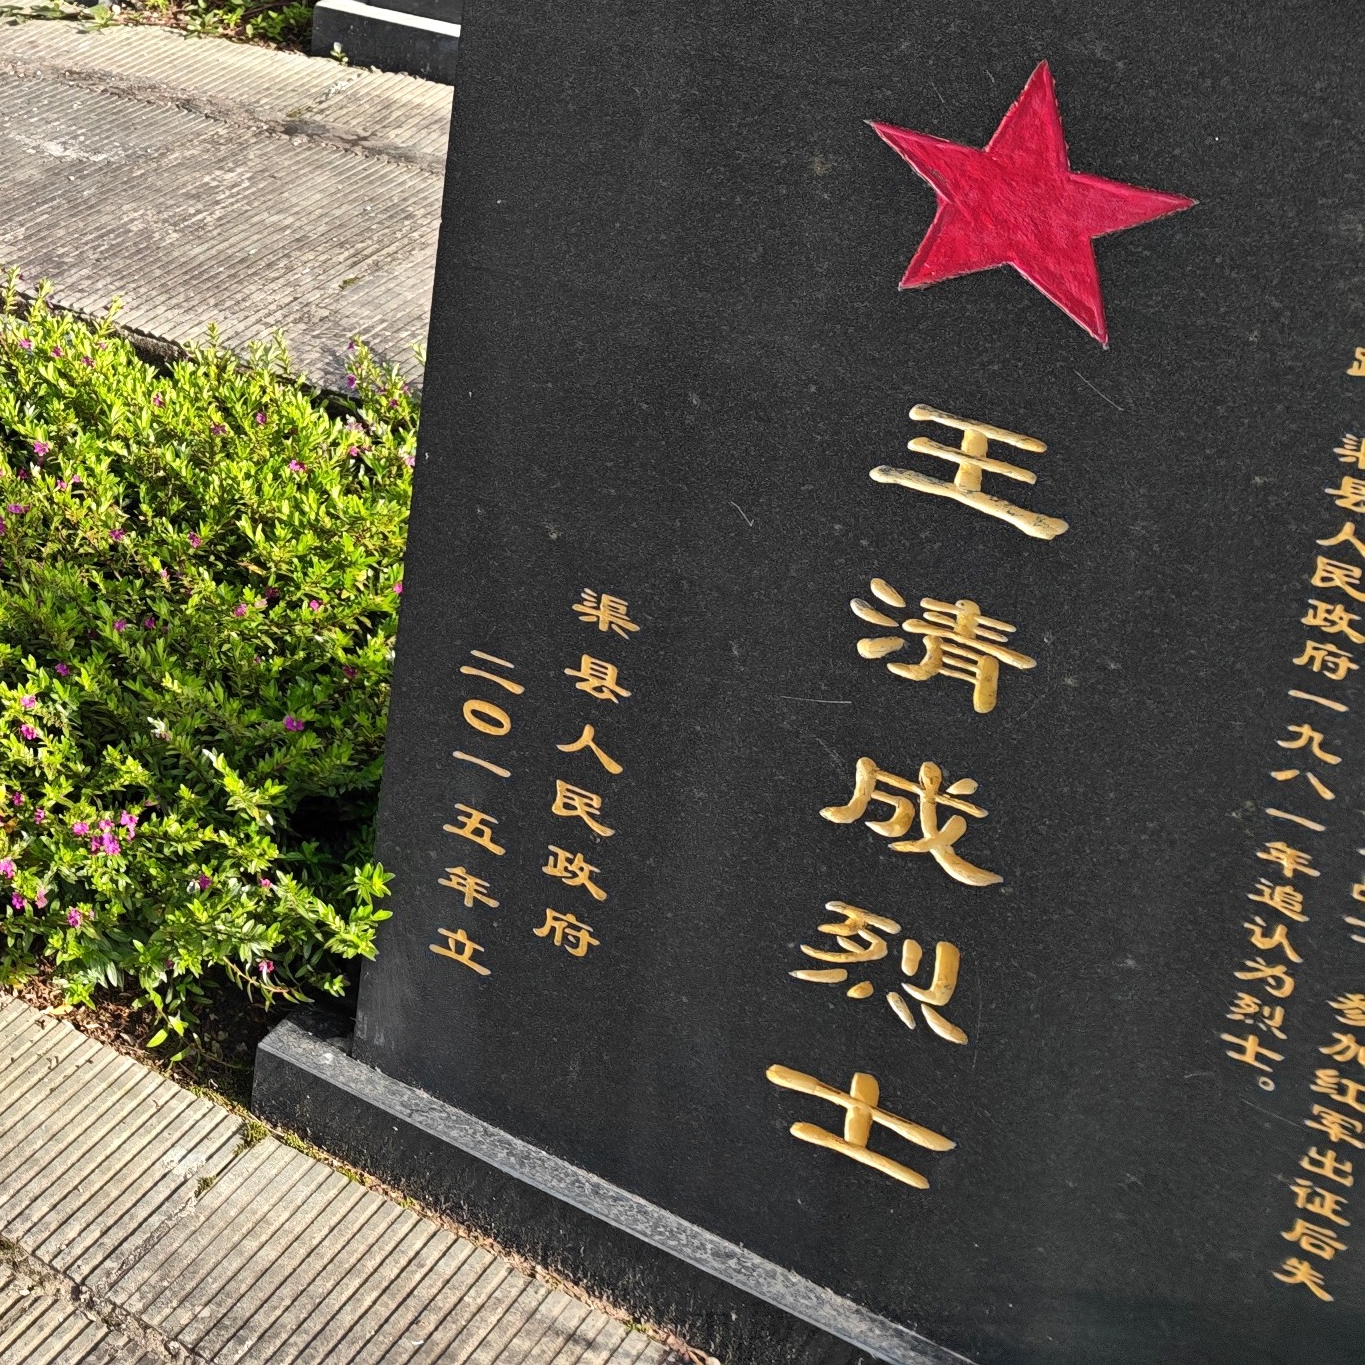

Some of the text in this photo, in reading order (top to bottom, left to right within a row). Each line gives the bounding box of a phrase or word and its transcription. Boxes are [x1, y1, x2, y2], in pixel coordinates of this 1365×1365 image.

[533, 587, 640, 959] 渠县人民政府
[765, 403, 1069, 1190] 王清成烈士
